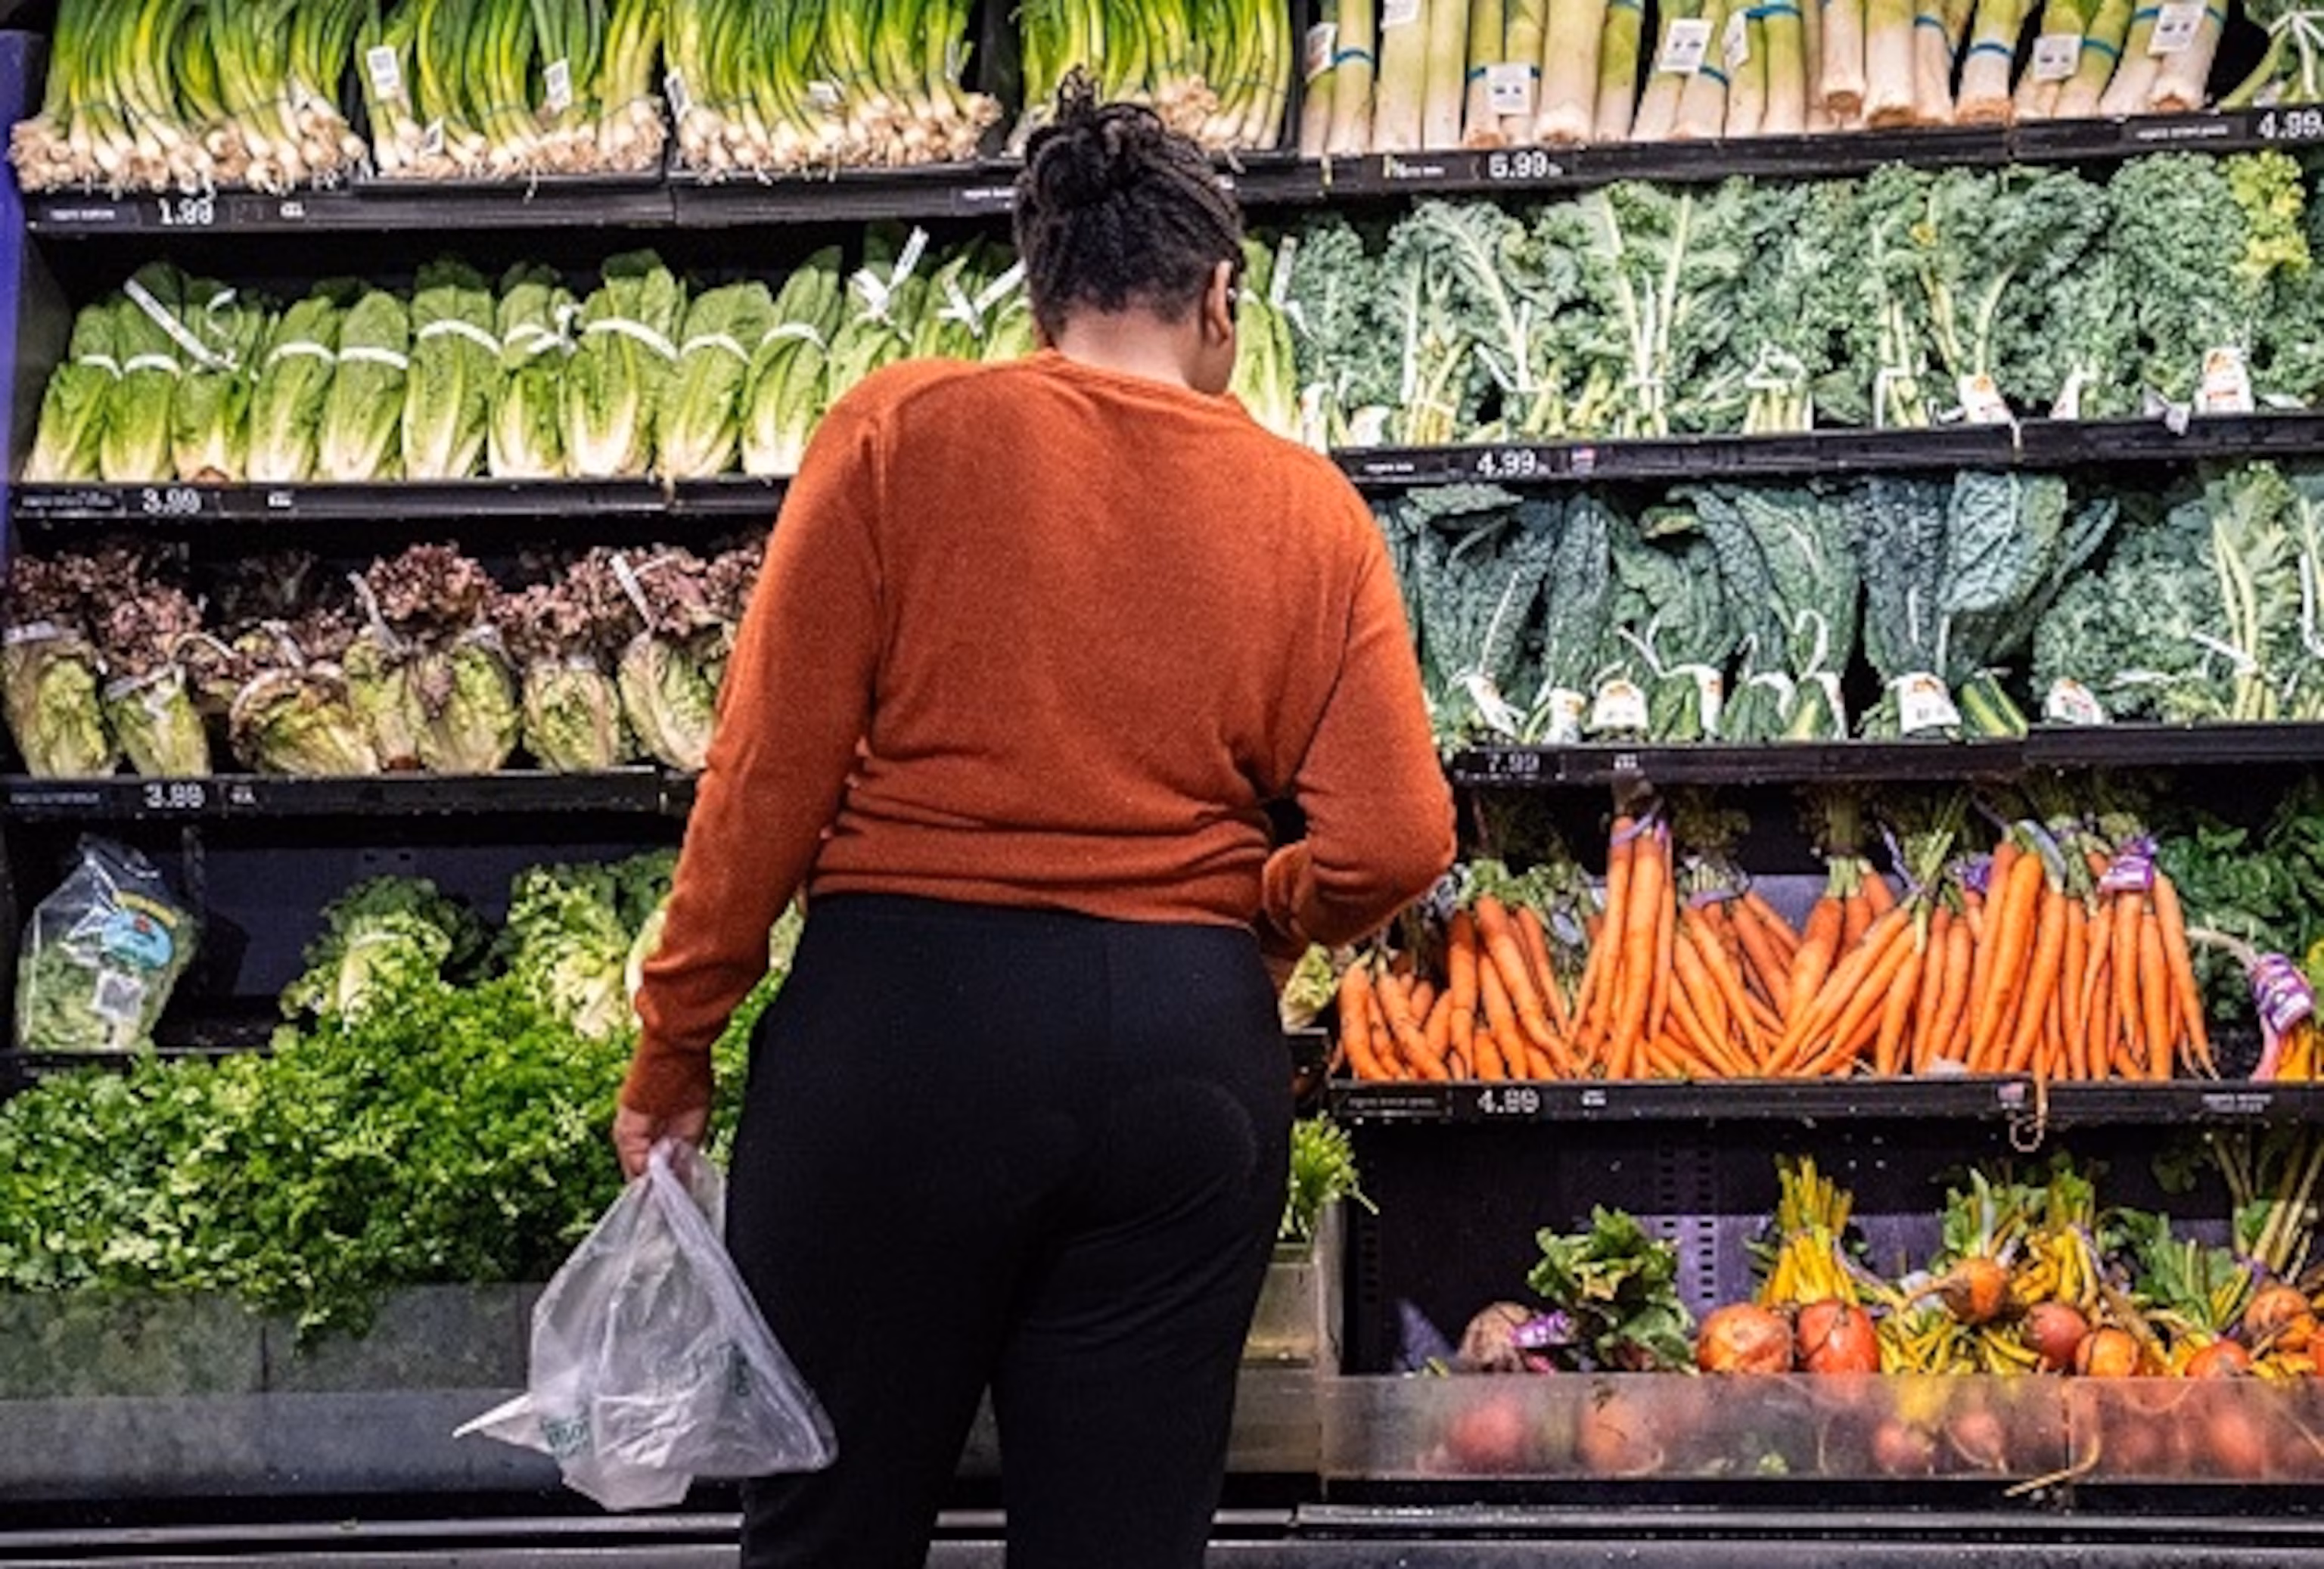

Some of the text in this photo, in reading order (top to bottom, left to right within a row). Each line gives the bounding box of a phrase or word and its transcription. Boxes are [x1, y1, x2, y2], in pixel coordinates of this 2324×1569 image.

[1488, 151, 1548, 178] 6.99
[1477, 449, 1536, 478] 4.99
[142, 488, 201, 514] 3.99
